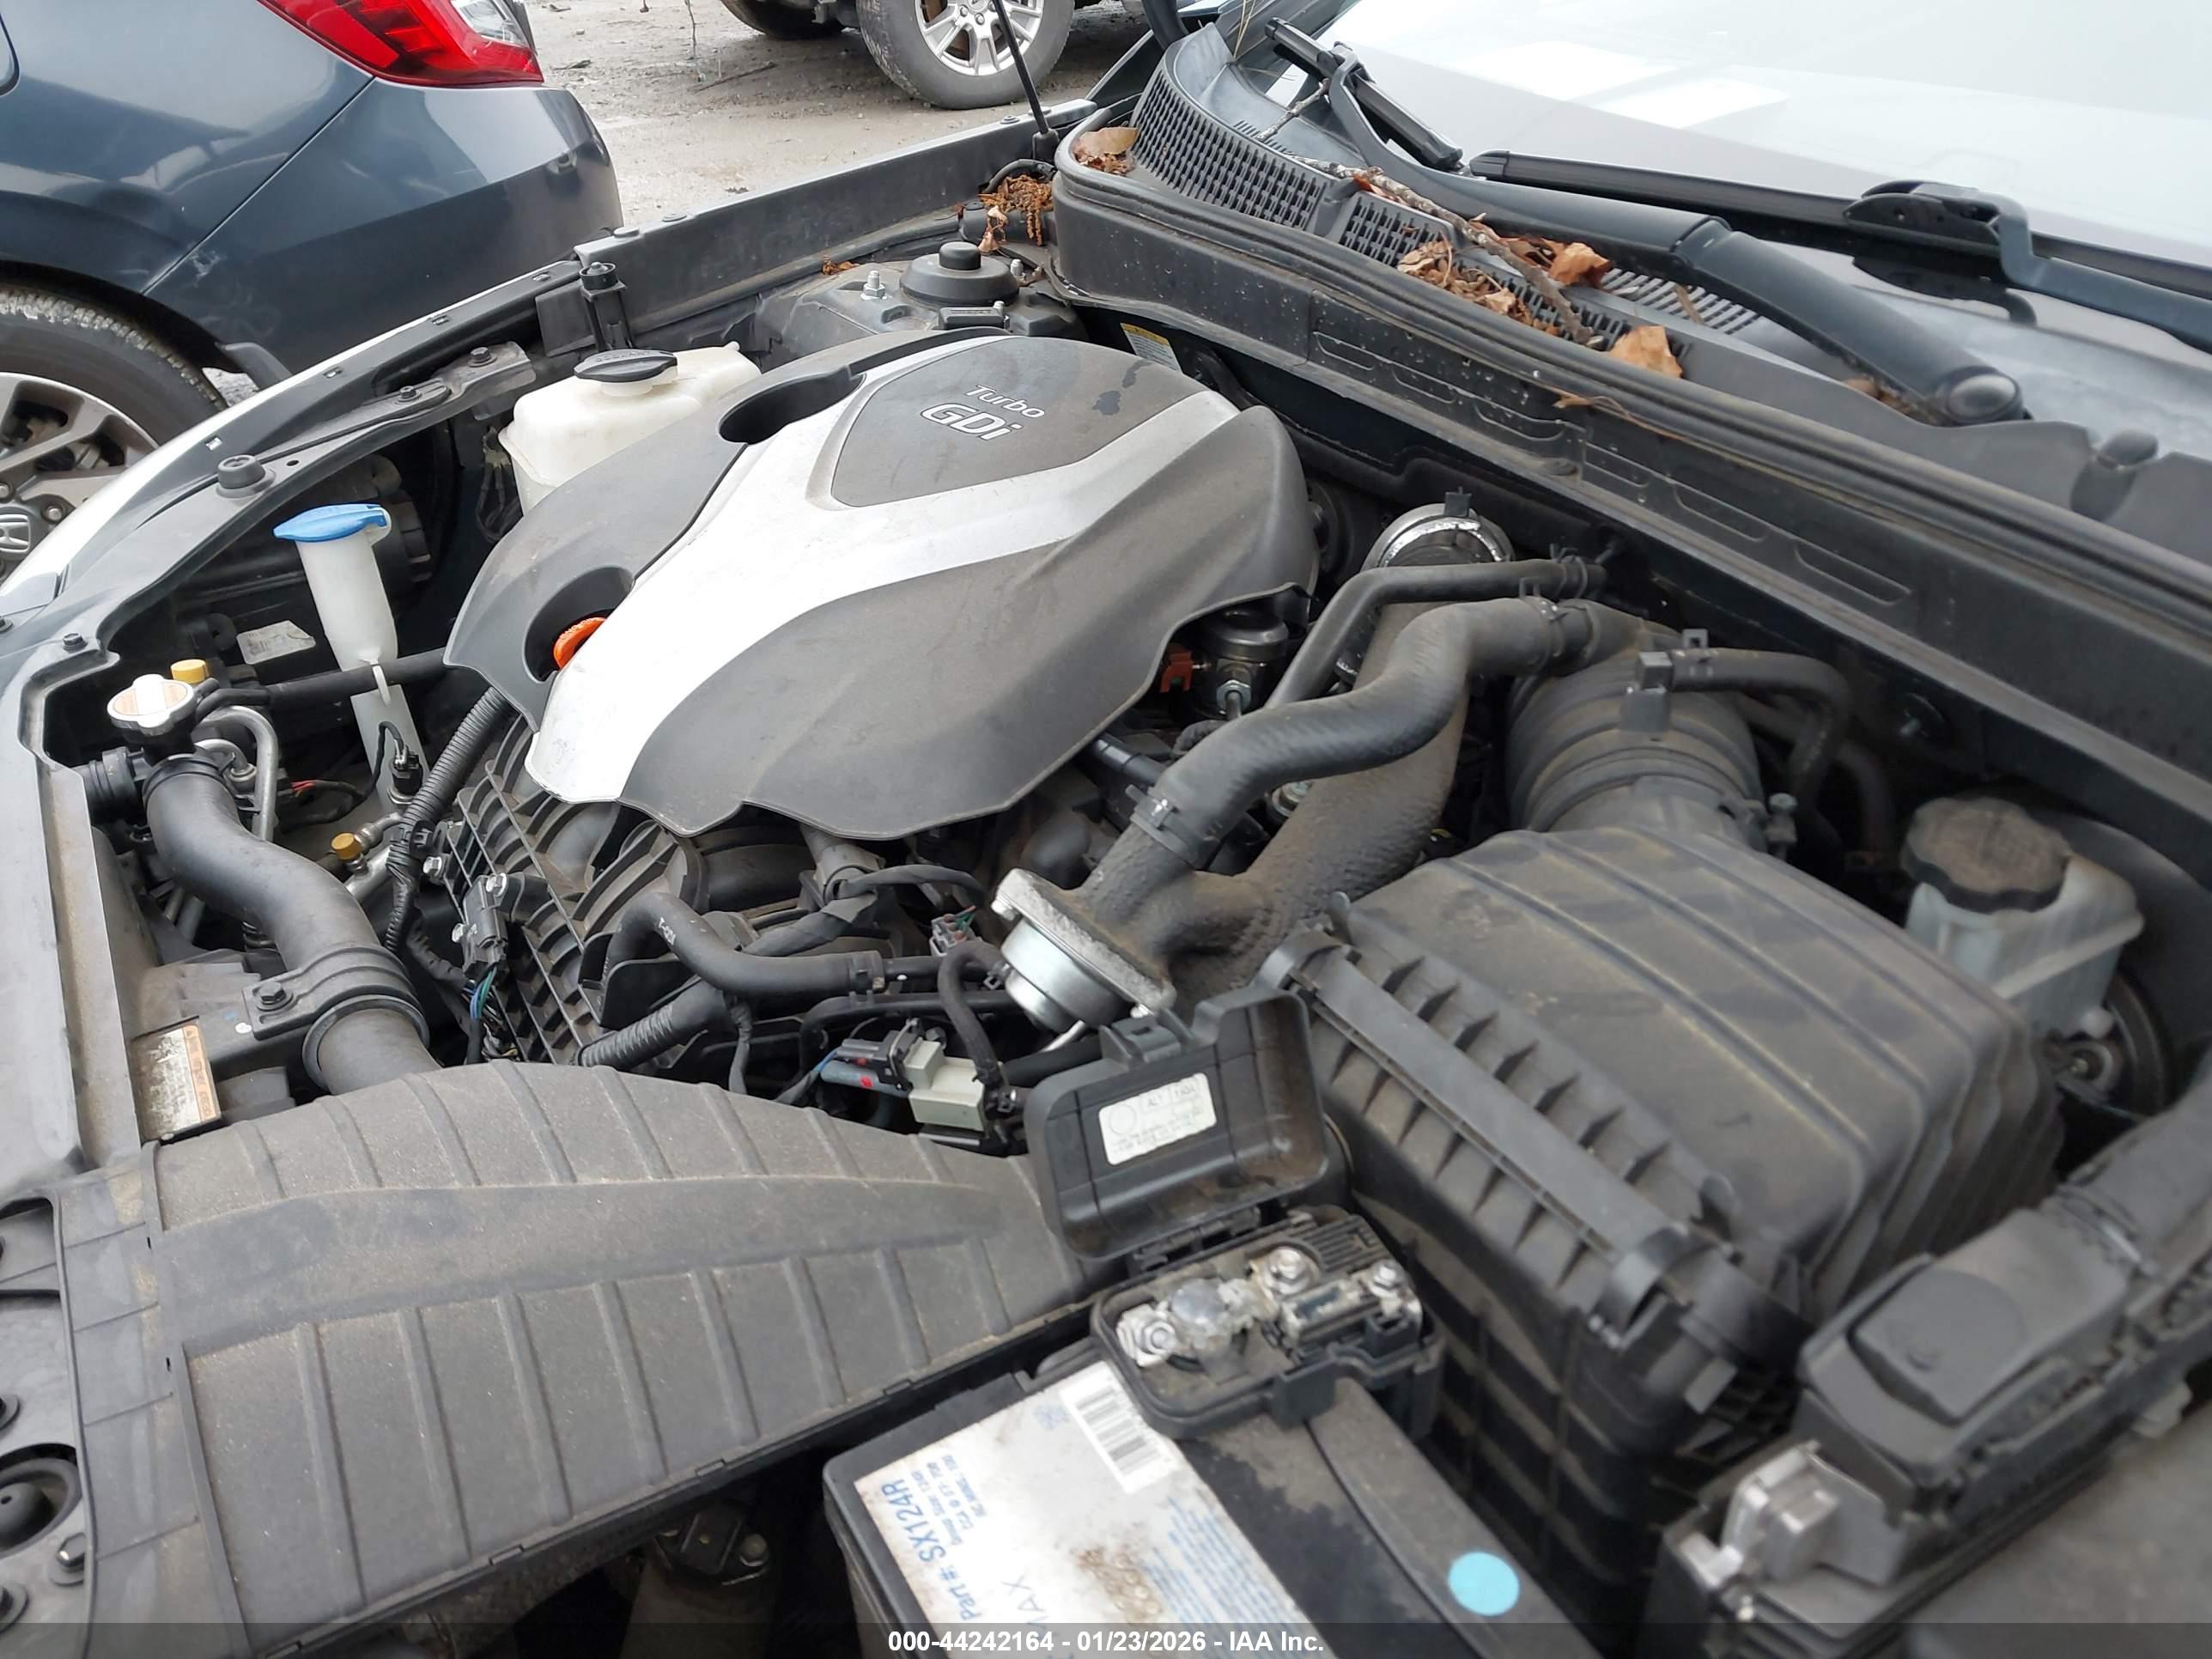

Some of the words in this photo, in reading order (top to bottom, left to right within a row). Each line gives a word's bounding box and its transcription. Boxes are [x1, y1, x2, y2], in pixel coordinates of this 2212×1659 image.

[963, 385, 1045, 418] Turbo
[921, 403, 1024, 441] GDi
[881, 1479, 945, 1561] SX124R
[949, 1583, 982, 1620] Part
